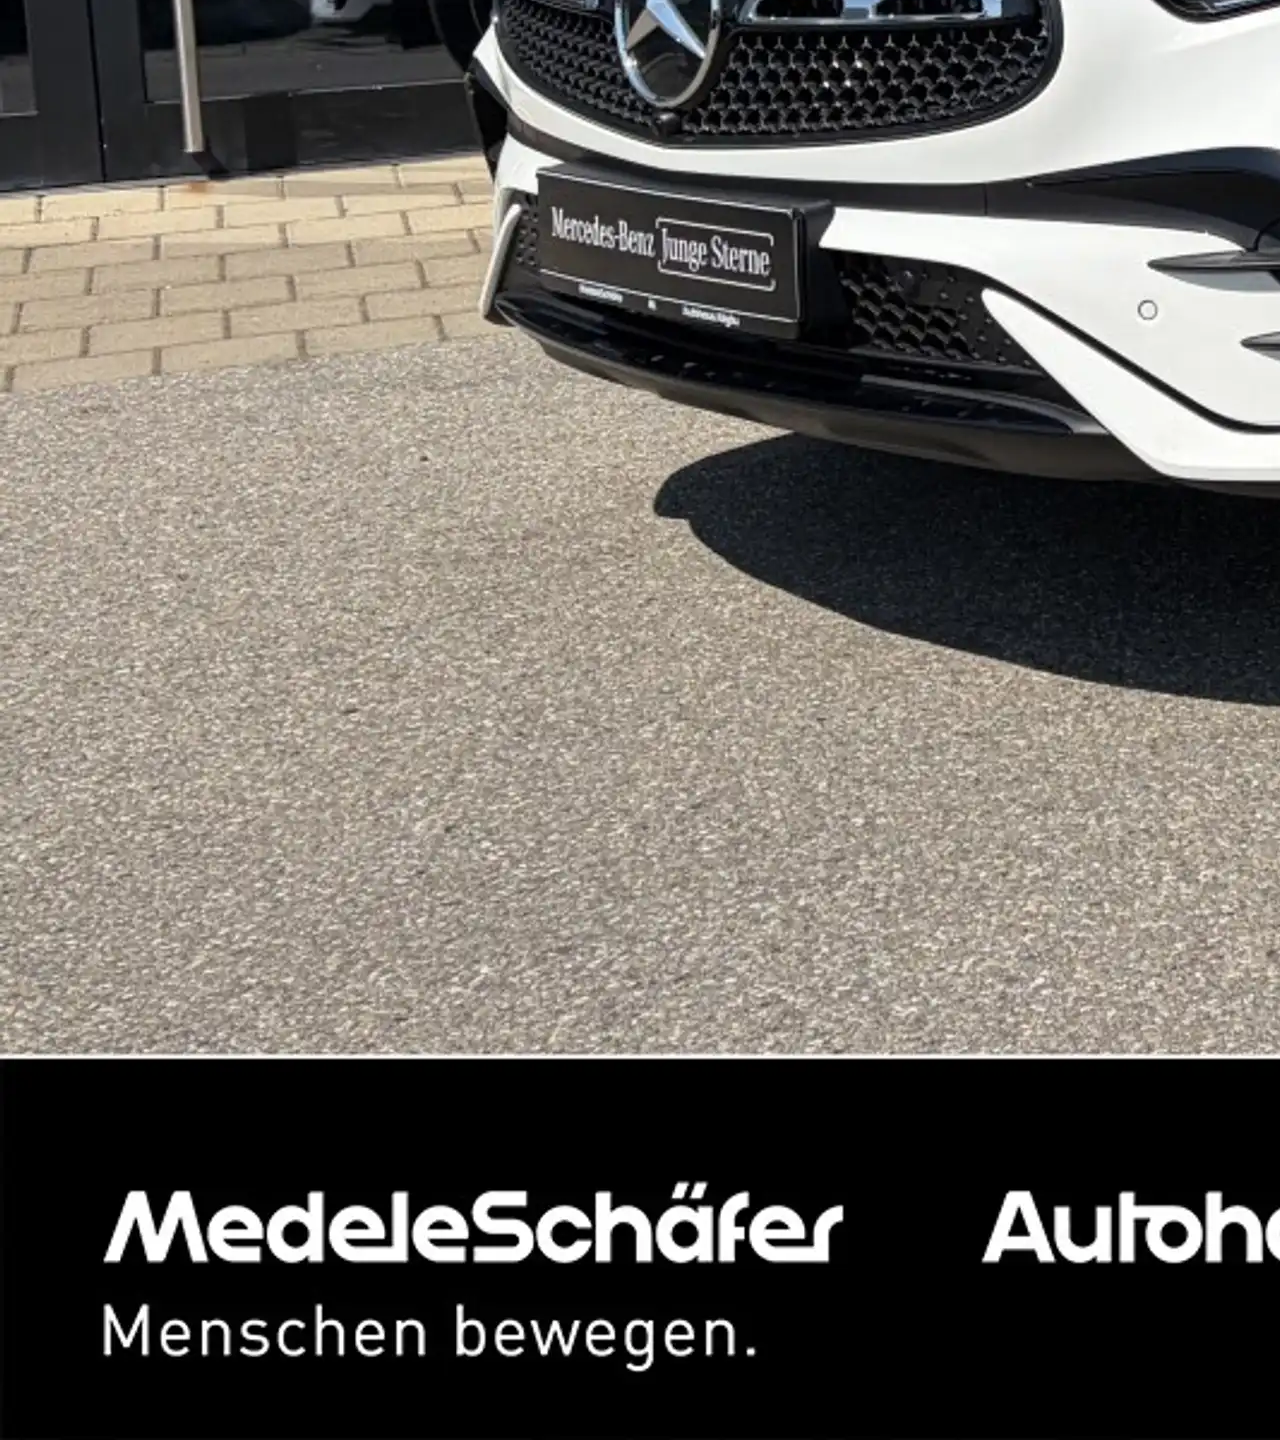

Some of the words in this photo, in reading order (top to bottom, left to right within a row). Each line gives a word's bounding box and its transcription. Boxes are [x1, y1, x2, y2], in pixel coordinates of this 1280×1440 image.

[551, 205, 656, 259] Mercedes-Benz
[661, 227, 708, 272] Junge
[710, 234, 771, 277] Sterne
